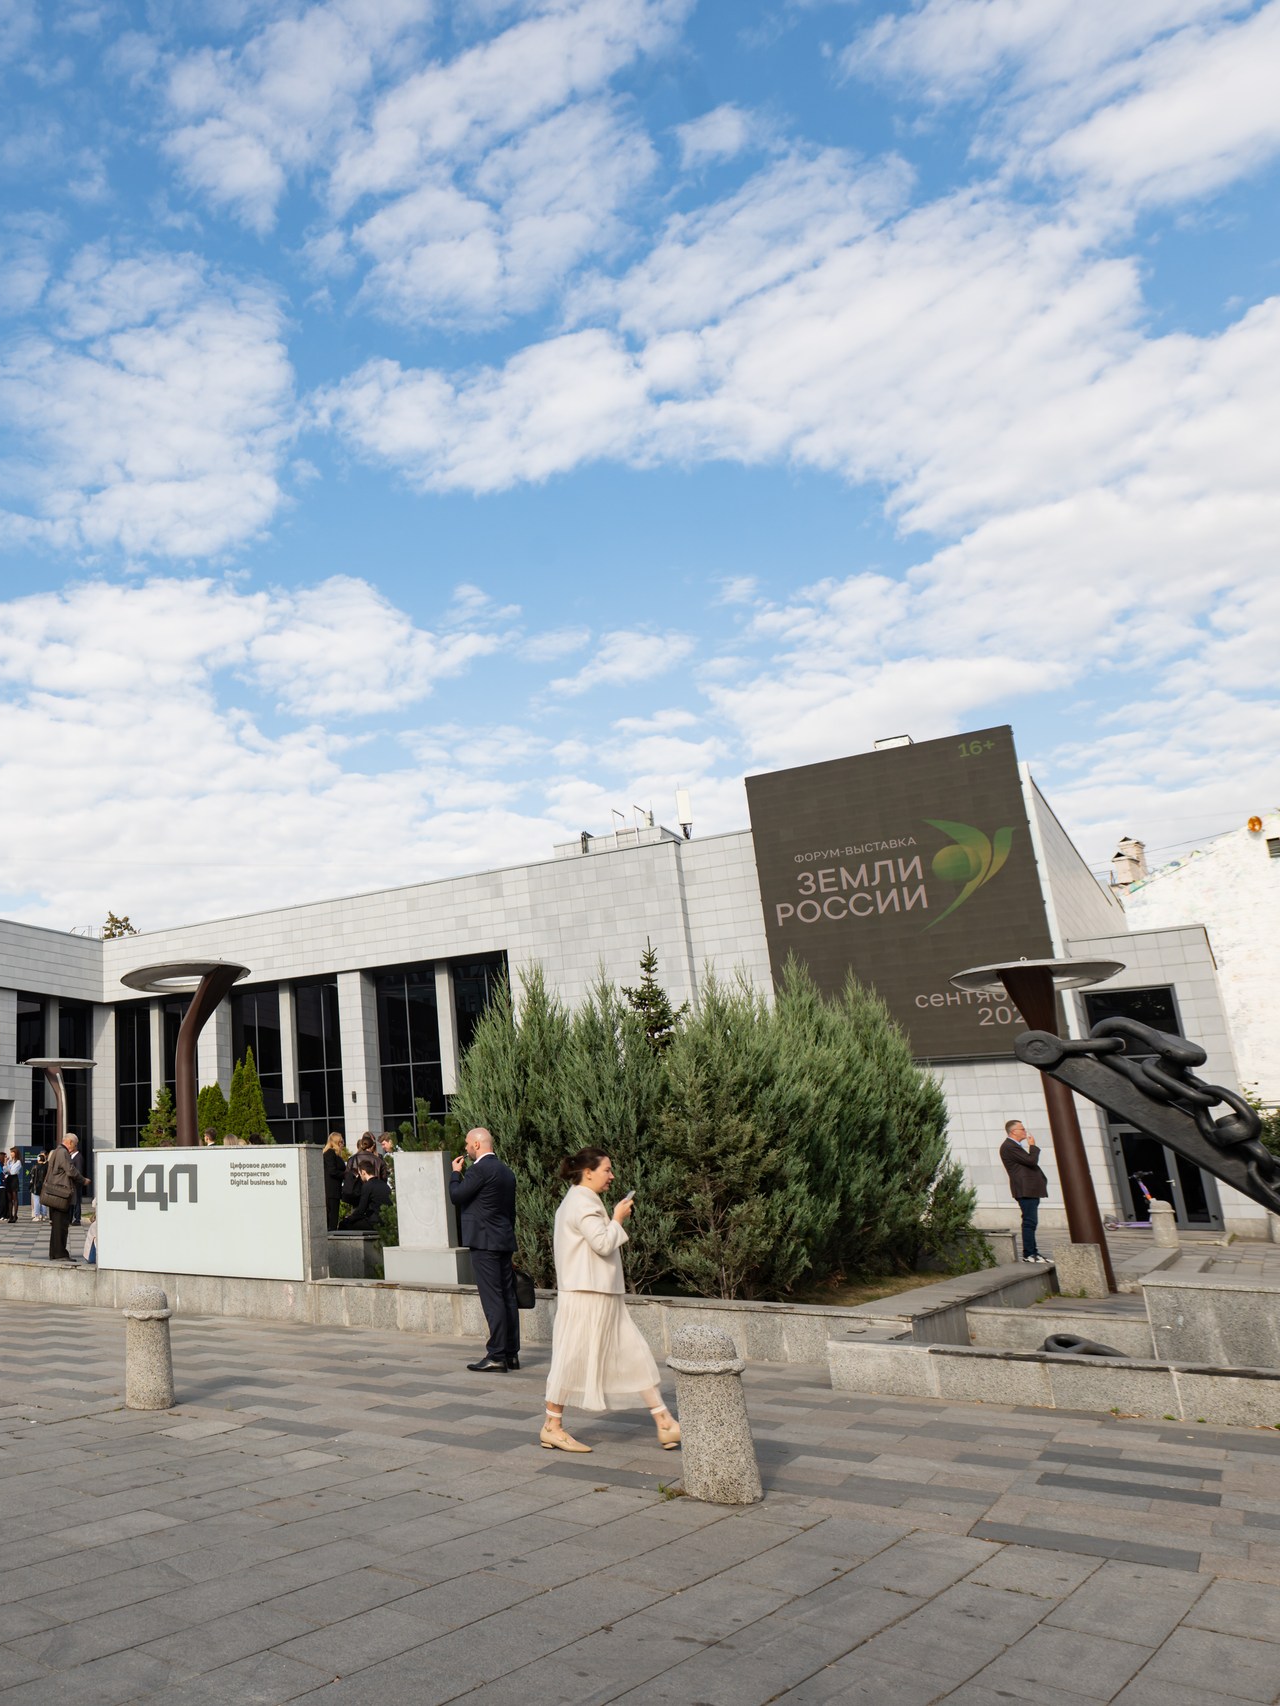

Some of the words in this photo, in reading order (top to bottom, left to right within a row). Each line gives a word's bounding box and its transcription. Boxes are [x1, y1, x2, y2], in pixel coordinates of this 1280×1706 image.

[958, 740, 995, 758] 16+
[793, 836, 917, 864] ФОРУМ-ВЫСТАВКА
[797, 855, 924, 896] ЗЕМЛИ
[775, 884, 929, 927] РОССИИ
[230, 1162, 260, 1170] Цифровое
[106, 1163, 199, 1212] ЦДП
[230, 1179, 249, 1187] Digital
